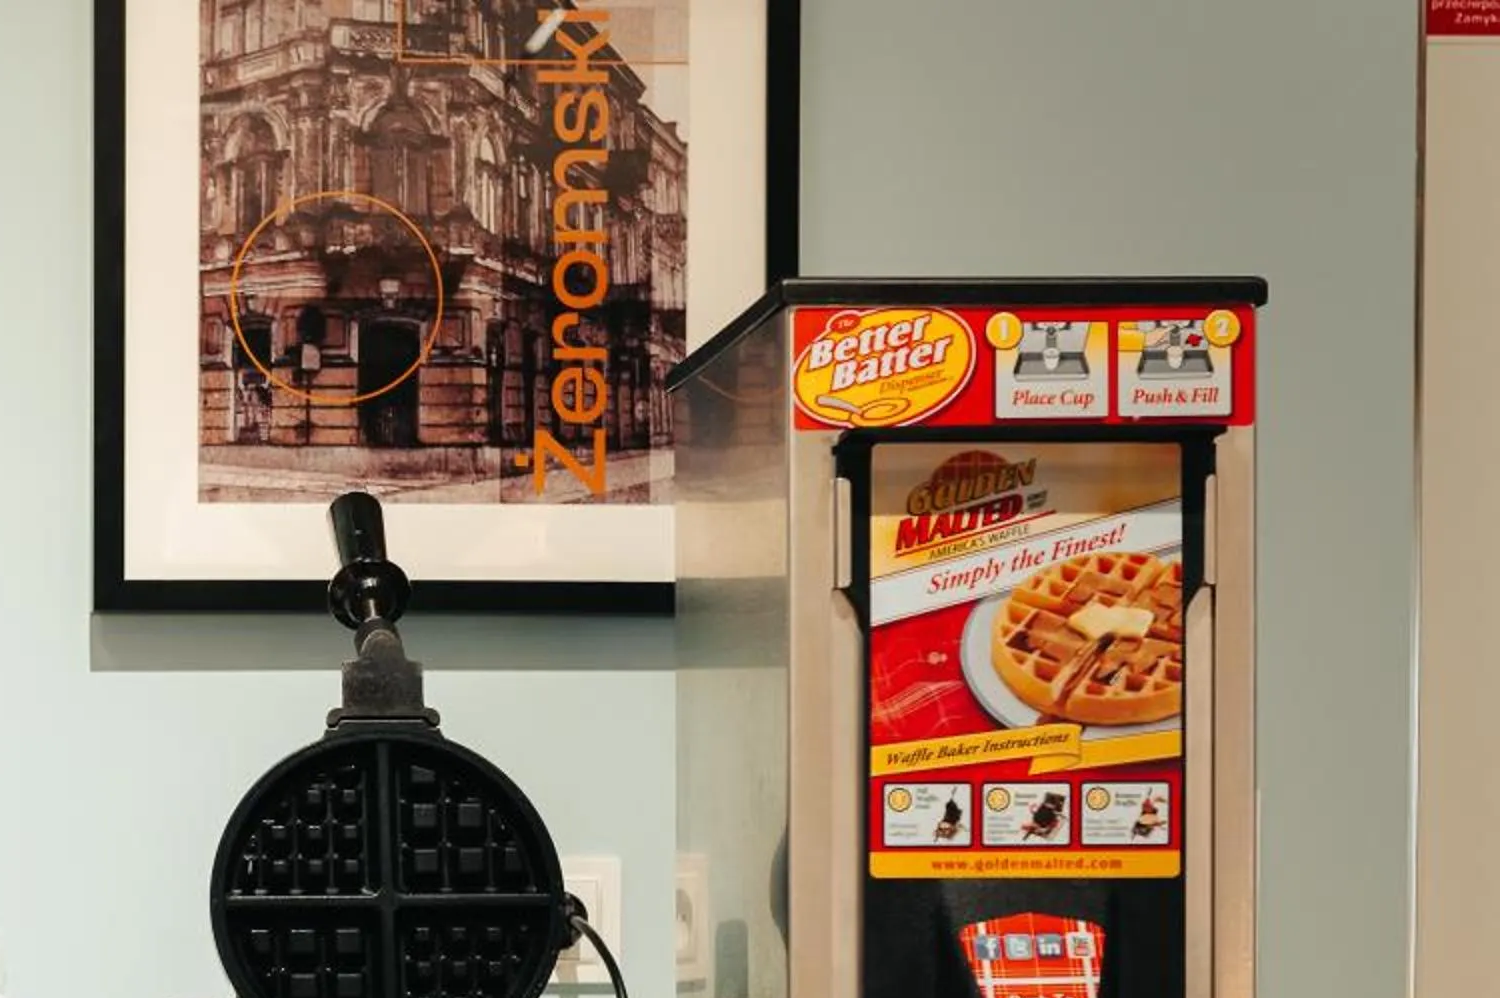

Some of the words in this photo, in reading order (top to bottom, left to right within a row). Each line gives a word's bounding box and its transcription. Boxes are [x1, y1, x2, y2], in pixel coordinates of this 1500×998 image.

[515, 9, 610, 497] Żeromski
[1000, 320, 1009, 341] 1
[1215, 319, 1229, 337] 2
[808, 315, 932, 371] Better
[830, 336, 951, 391] Batter
[879, 370, 946, 393] Dispenser
[1011, 390, 1057, 408] Place
[1061, 389, 1094, 408] Cup
[1132, 388, 1172, 405] Push
[1175, 390, 1187, 404] &
[1191, 387, 1220, 405] Fill
[906, 457, 1037, 516] GOLDEN
[895, 493, 1025, 551] MALTED
[988, 523, 1030, 545] WAFFLE
[926, 561, 1005, 595] Simply
[1010, 546, 1045, 573] the
[1051, 523, 1128, 561] Finest!
[886, 748, 934, 766] Waffle
[937, 743, 980, 759] Baker
[983, 732, 1071, 753] Instructions
[931, 858, 1123, 871] www.goldenmalted.com
